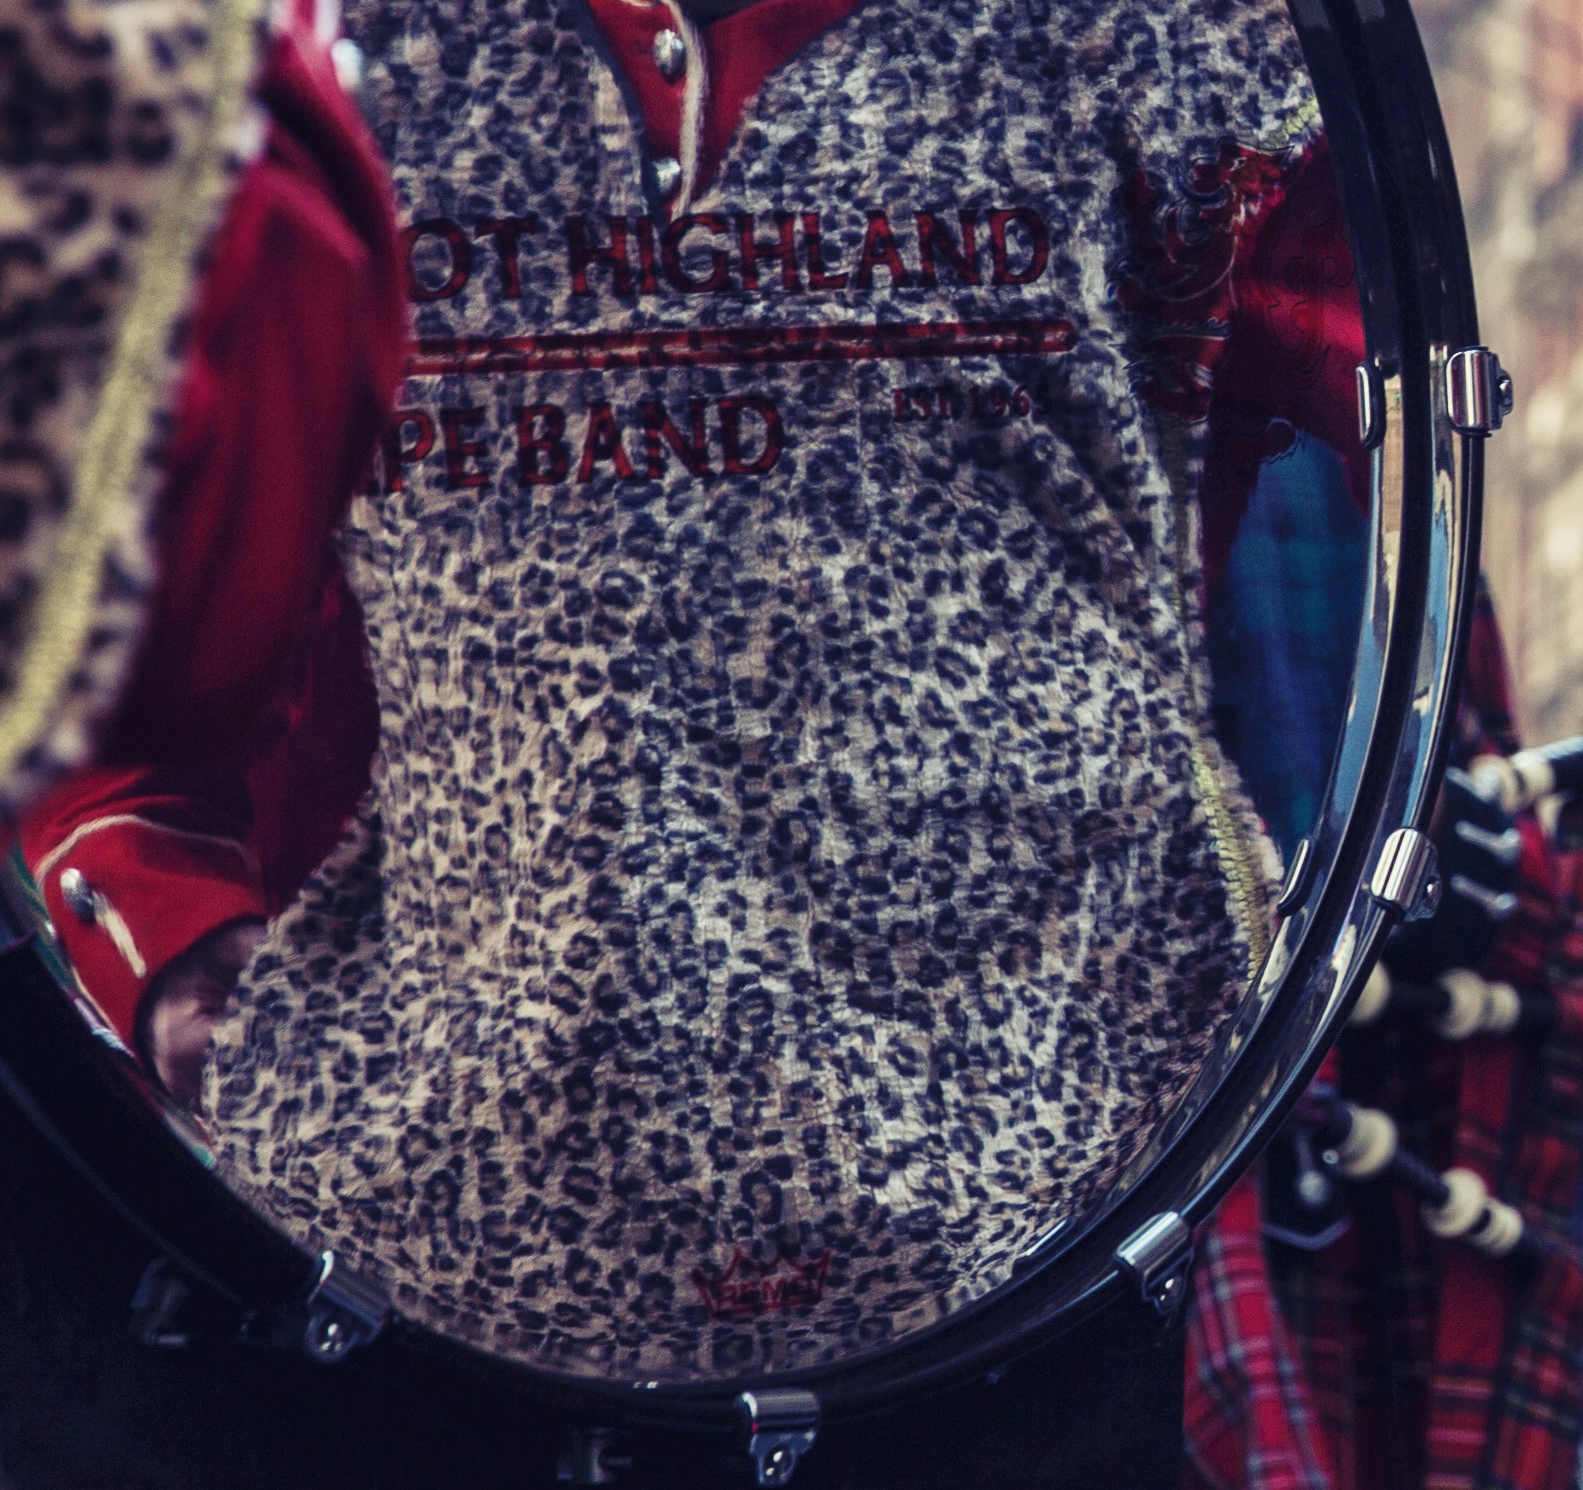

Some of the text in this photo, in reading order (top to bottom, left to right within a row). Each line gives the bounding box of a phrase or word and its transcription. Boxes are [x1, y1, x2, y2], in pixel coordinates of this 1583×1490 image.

[400, 208, 1049, 301] OT HIGHLAND
[386, 397, 785, 491] PE BAND
